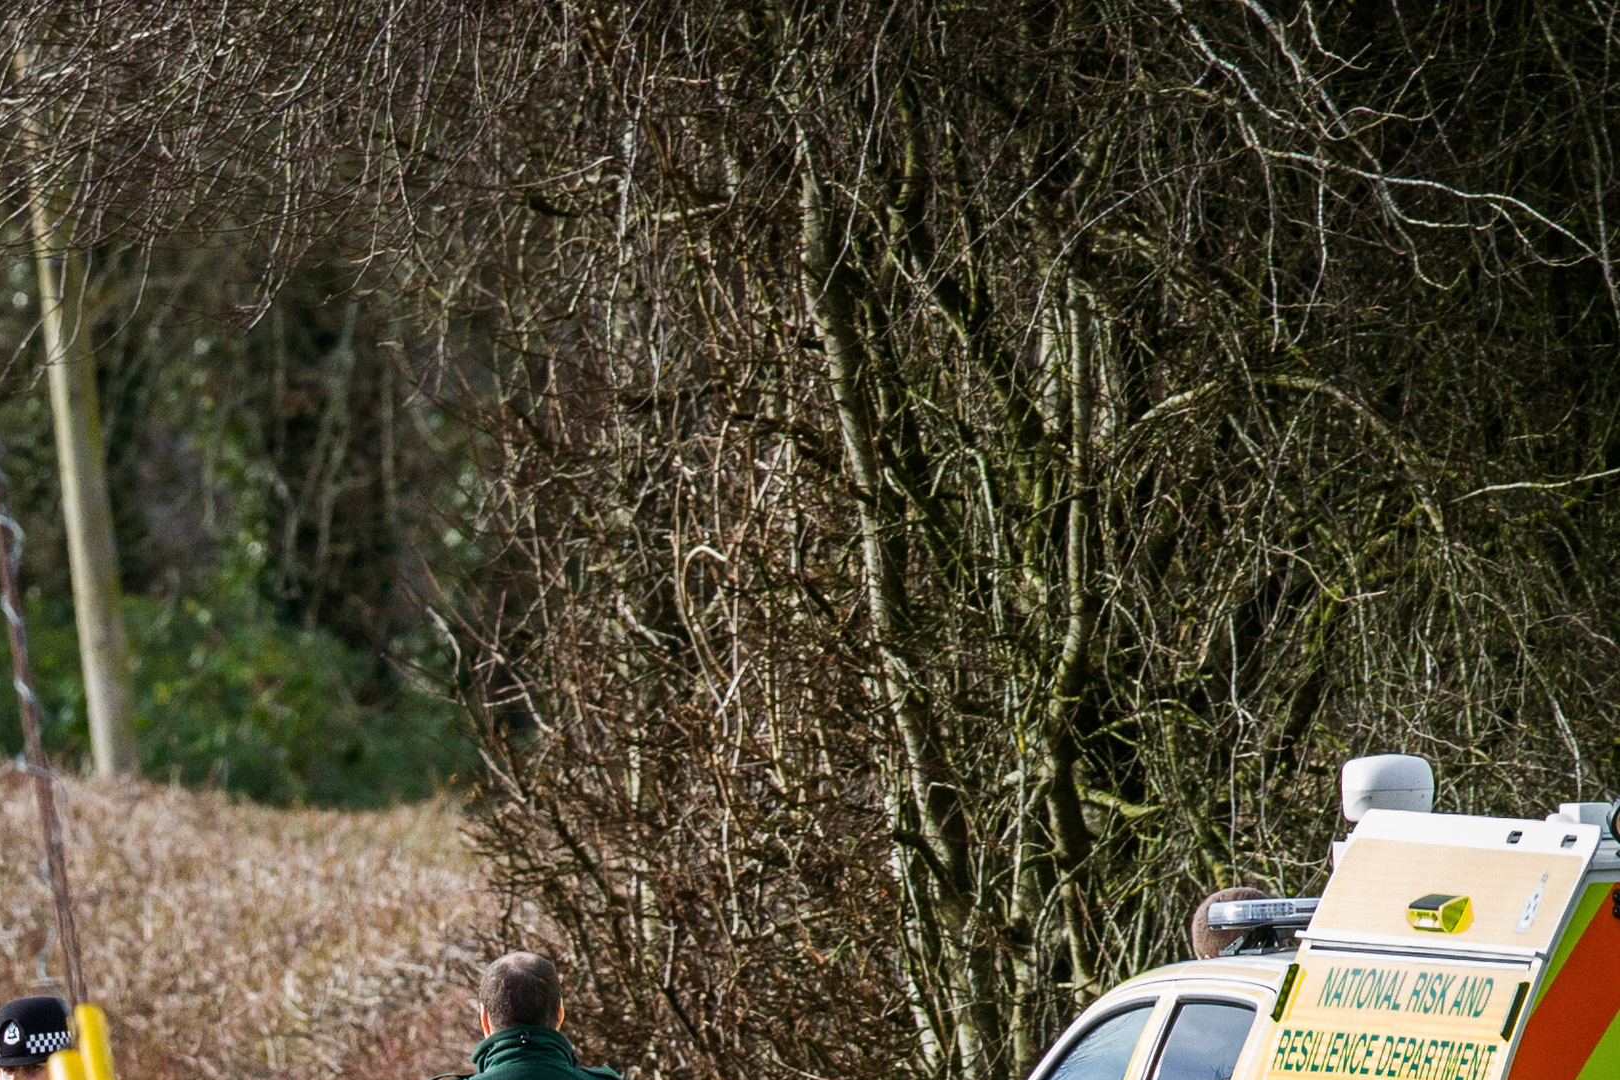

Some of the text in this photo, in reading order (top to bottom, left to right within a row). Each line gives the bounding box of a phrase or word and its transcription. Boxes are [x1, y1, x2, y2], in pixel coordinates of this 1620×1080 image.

[1317, 966, 1494, 1018] NATIONAL RISK AND
[1272, 1029, 1379, 1075] RESILIENCE
